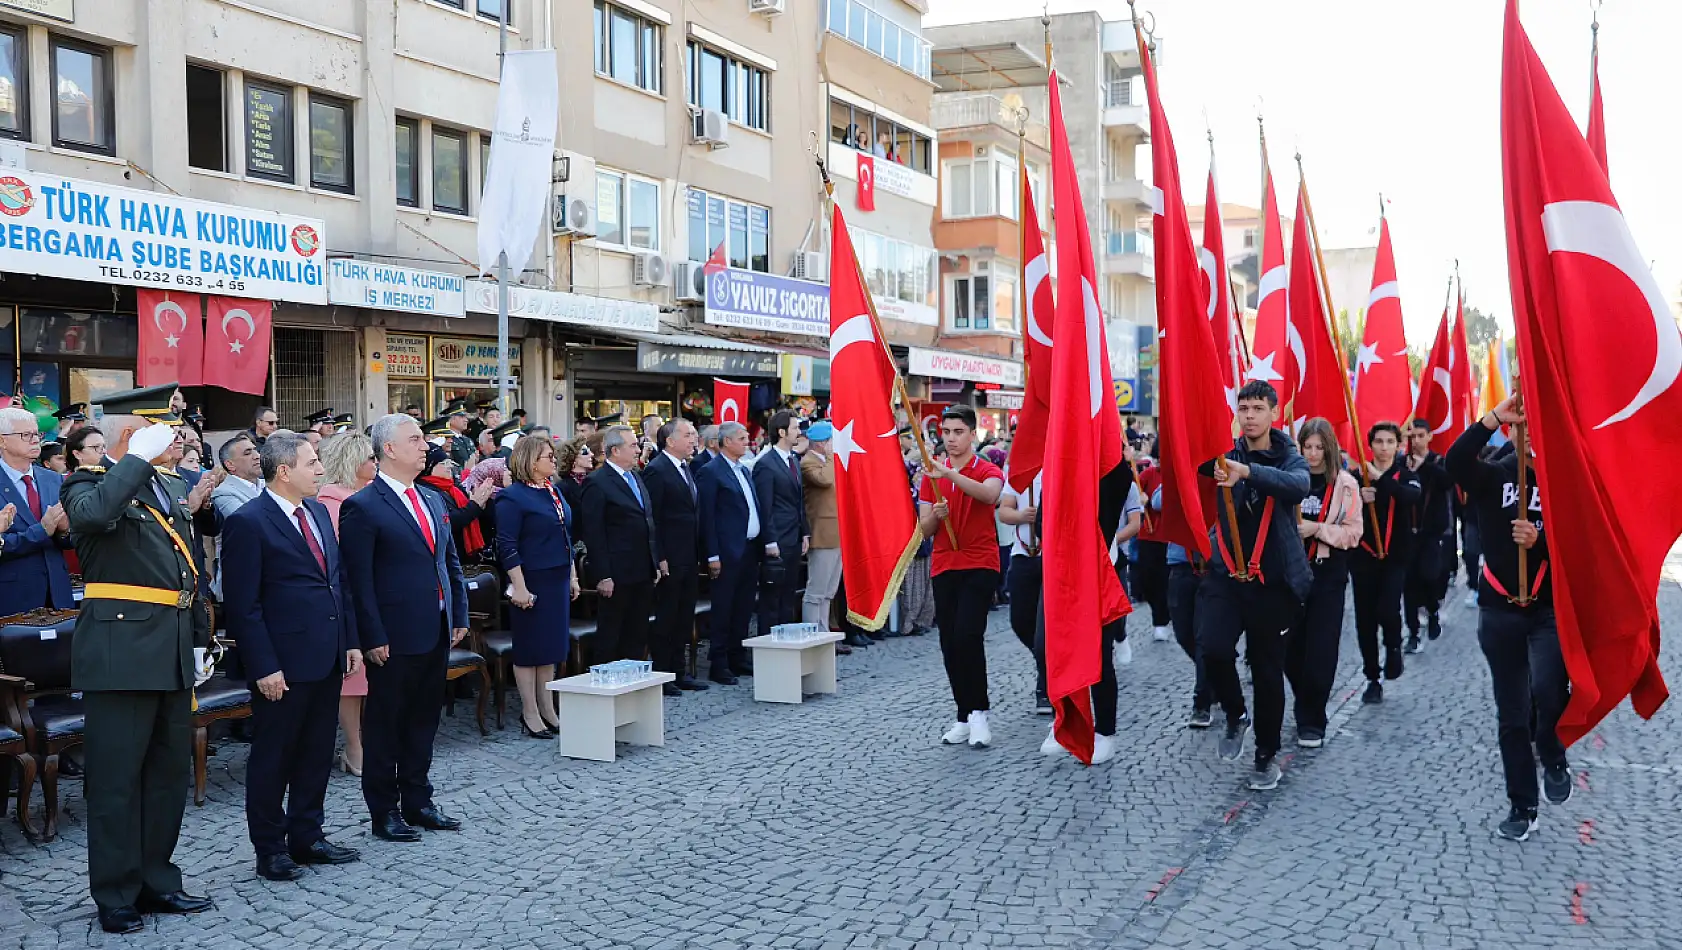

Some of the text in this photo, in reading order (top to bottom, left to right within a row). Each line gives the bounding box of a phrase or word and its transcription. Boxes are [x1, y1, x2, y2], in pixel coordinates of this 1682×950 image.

[41, 181, 287, 252] TÜRK HAVA KURUMU
[132, 240, 191, 278] ŞUBE
[200, 249, 322, 286] BAŞKANLIĞI
[176, 274, 203, 286] 633
[333, 260, 461, 292] TÜRK HAVA KURUMU
[364, 286, 435, 310] İŞ MERKEZİ
[730, 282, 777, 314] YAVUZ
[388, 354, 422, 364] 32 33 23
[477, 361, 499, 376] DÖNE
[931, 355, 960, 370] UYGUN
